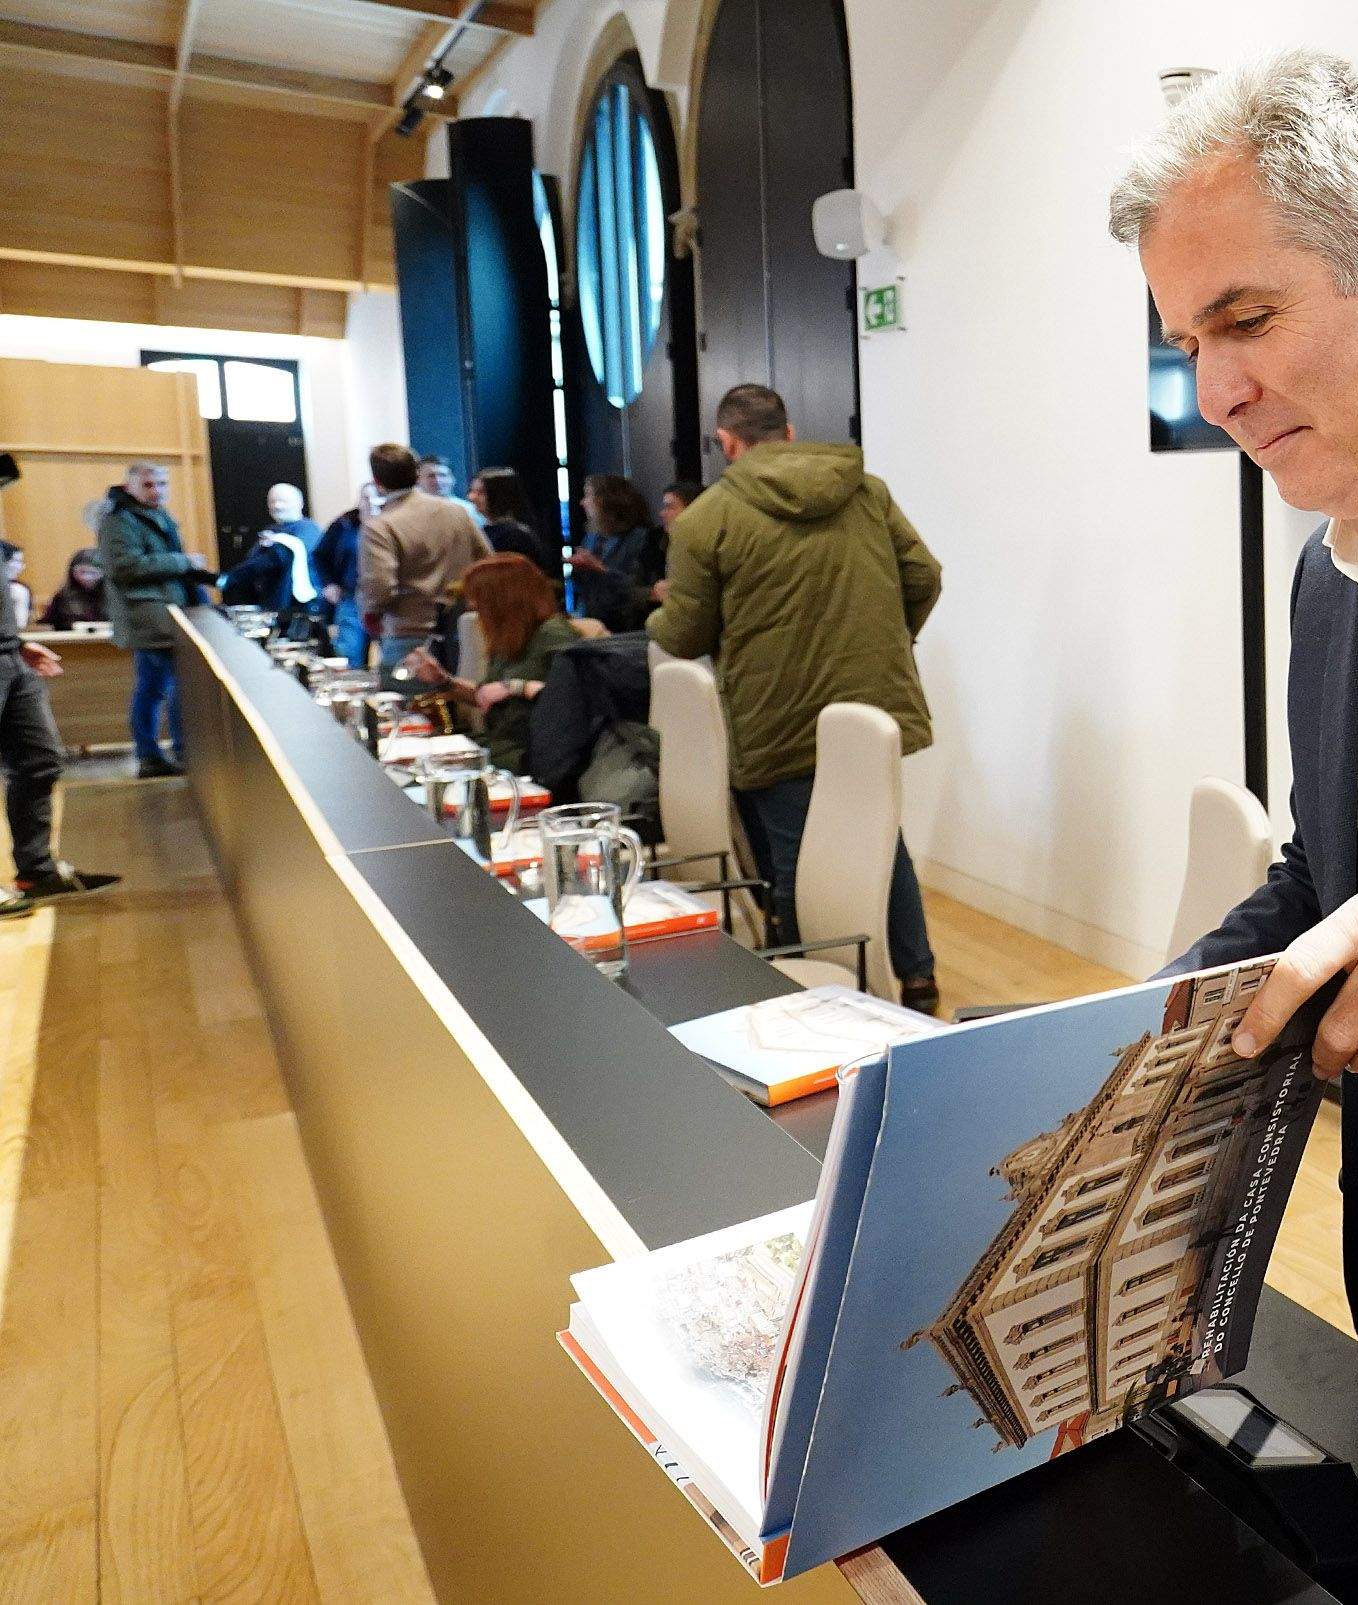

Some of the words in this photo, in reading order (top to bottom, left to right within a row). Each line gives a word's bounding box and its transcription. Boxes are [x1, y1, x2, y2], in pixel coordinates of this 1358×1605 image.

[1202, 1238, 1241, 1359] REHABILITACIÓN
[1235, 1212, 1248, 1233] DA
[1243, 1168, 1262, 1208] CASA
[1258, 1052, 1302, 1164] CONSISTORIAL
[1214, 1332, 1225, 1353] DO
[1220, 1253, 1247, 1327] CONCELLO
[1242, 1228, 1255, 1248] DE
[1249, 1124, 1288, 1224] PONTEVEDRA
